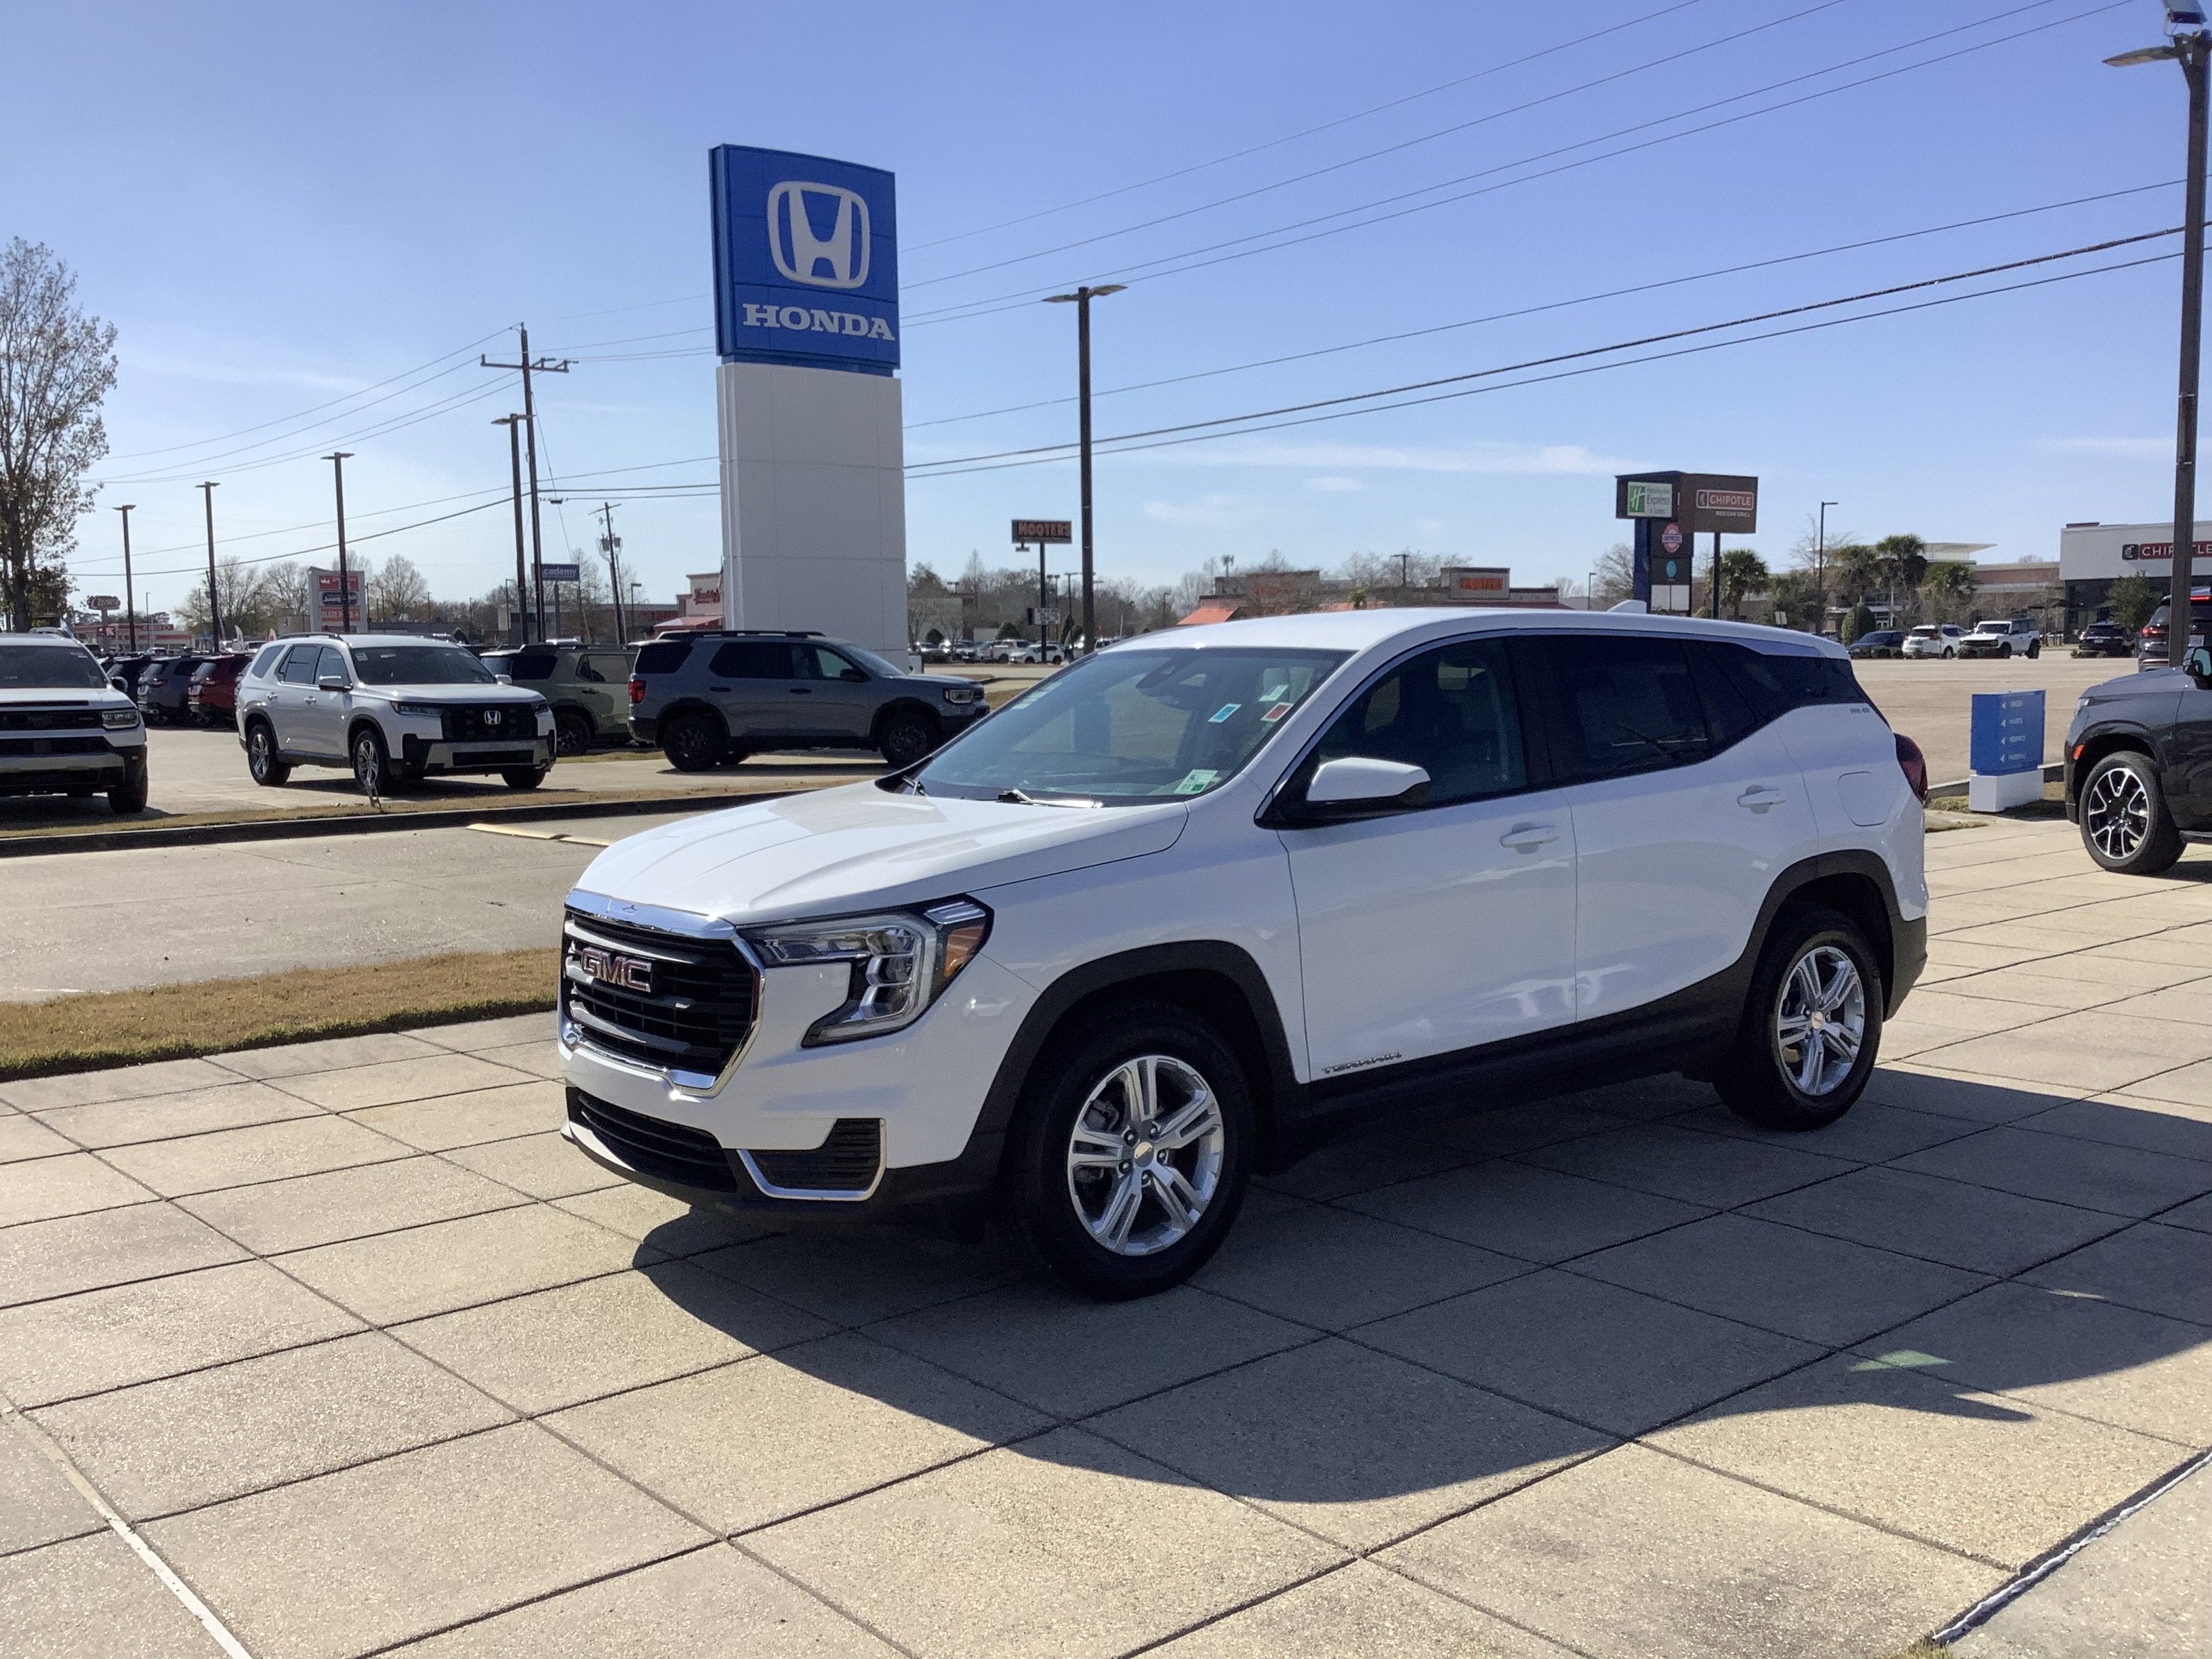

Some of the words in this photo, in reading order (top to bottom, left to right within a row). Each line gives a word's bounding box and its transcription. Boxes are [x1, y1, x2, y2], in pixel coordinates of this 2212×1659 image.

[743, 303, 895, 341] HONDA
[1710, 495, 1752, 506] CHIPOTLE
[581, 947, 653, 993] GMC
